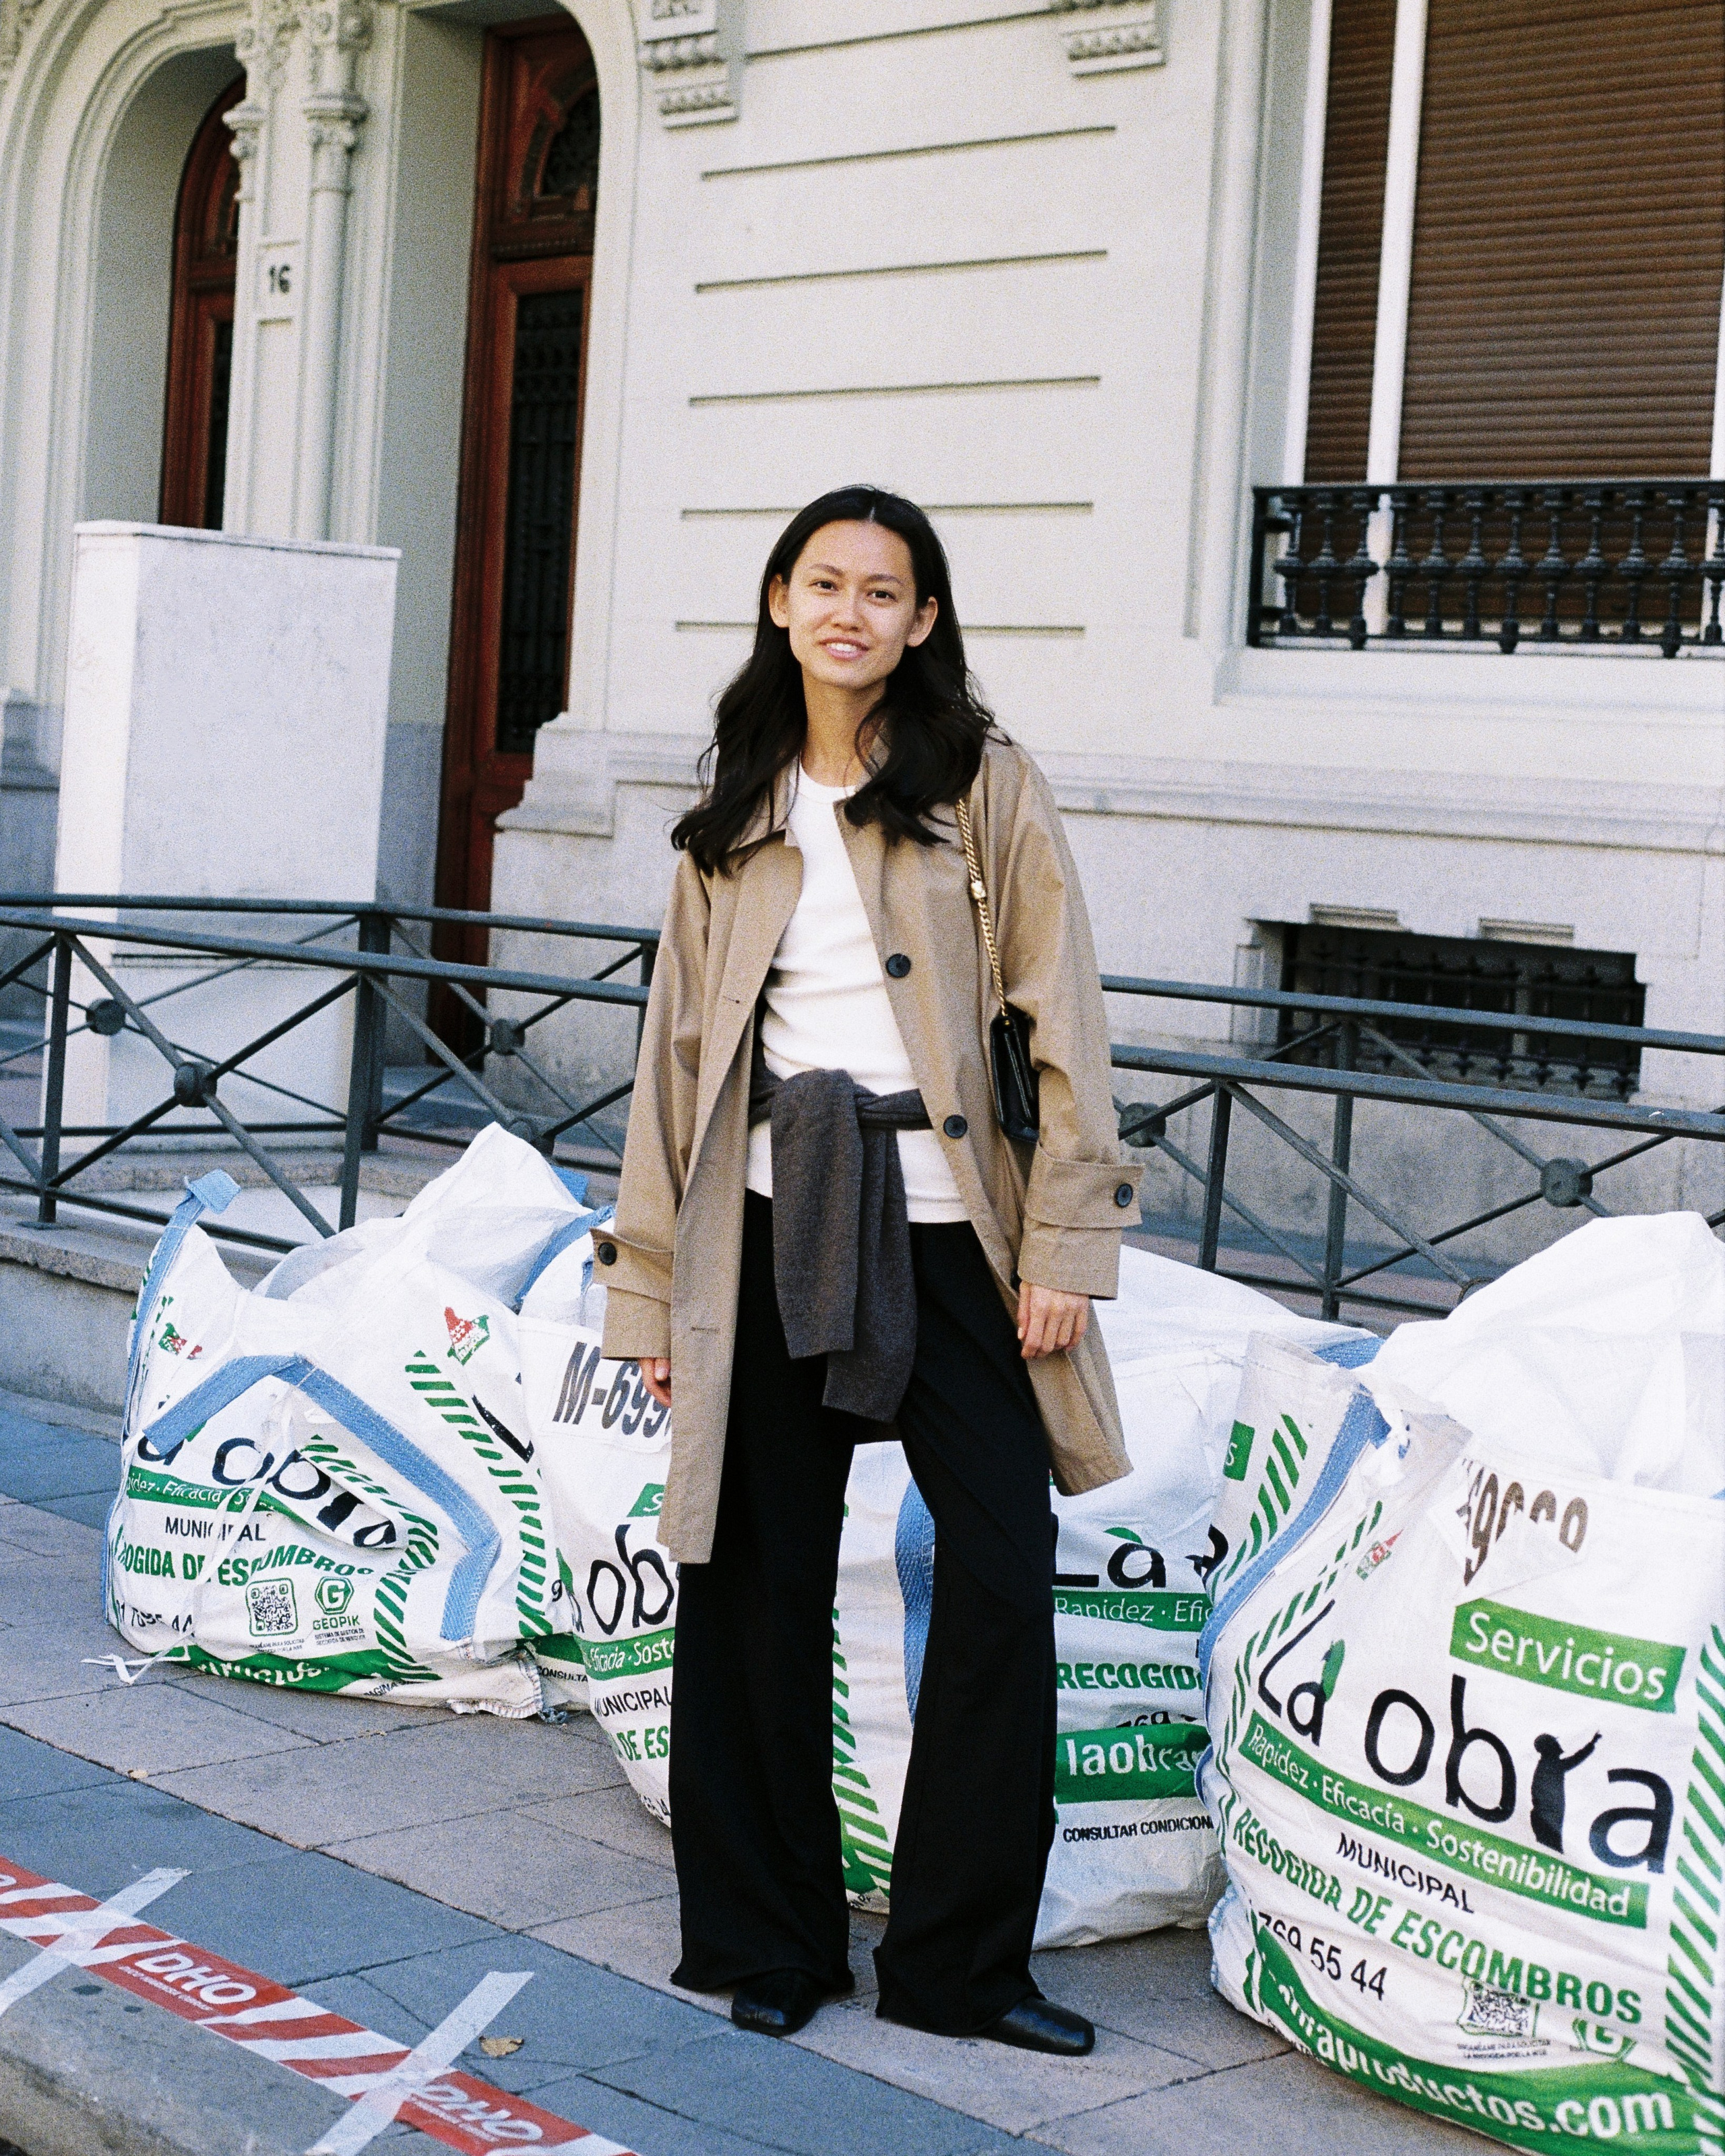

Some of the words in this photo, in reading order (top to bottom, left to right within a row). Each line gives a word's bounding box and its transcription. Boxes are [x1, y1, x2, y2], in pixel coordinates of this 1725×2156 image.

[269, 264, 290, 293] 16
[553, 1341, 671, 1438] M-699
[313, 1615, 360, 1630] GEOPIK
[1466, 1612, 1668, 1701] Servicios
[1258, 1599, 1335, 1746] La
[1365, 1674, 1673, 1874] obra
[1063, 1822, 1137, 1843] CONSULTAR
[1248, 1724, 1309, 1789] Rapidez
[1322, 1775, 1405, 1835] Eficacia
[1426, 1820, 1631, 1917] Sostenibilidad
[1336, 1832, 1475, 1914] MUNICIPAL
[1233, 1808, 1342, 1913] RECOGIDA
[1346, 1887, 1393, 1936] DE
[1390, 1909, 1642, 2023] ESCOMBROS
[135, 1953, 256, 2004] DHO
[1311, 1937, 1342, 1981] 55
[1351, 1959, 1388, 2001] 44
